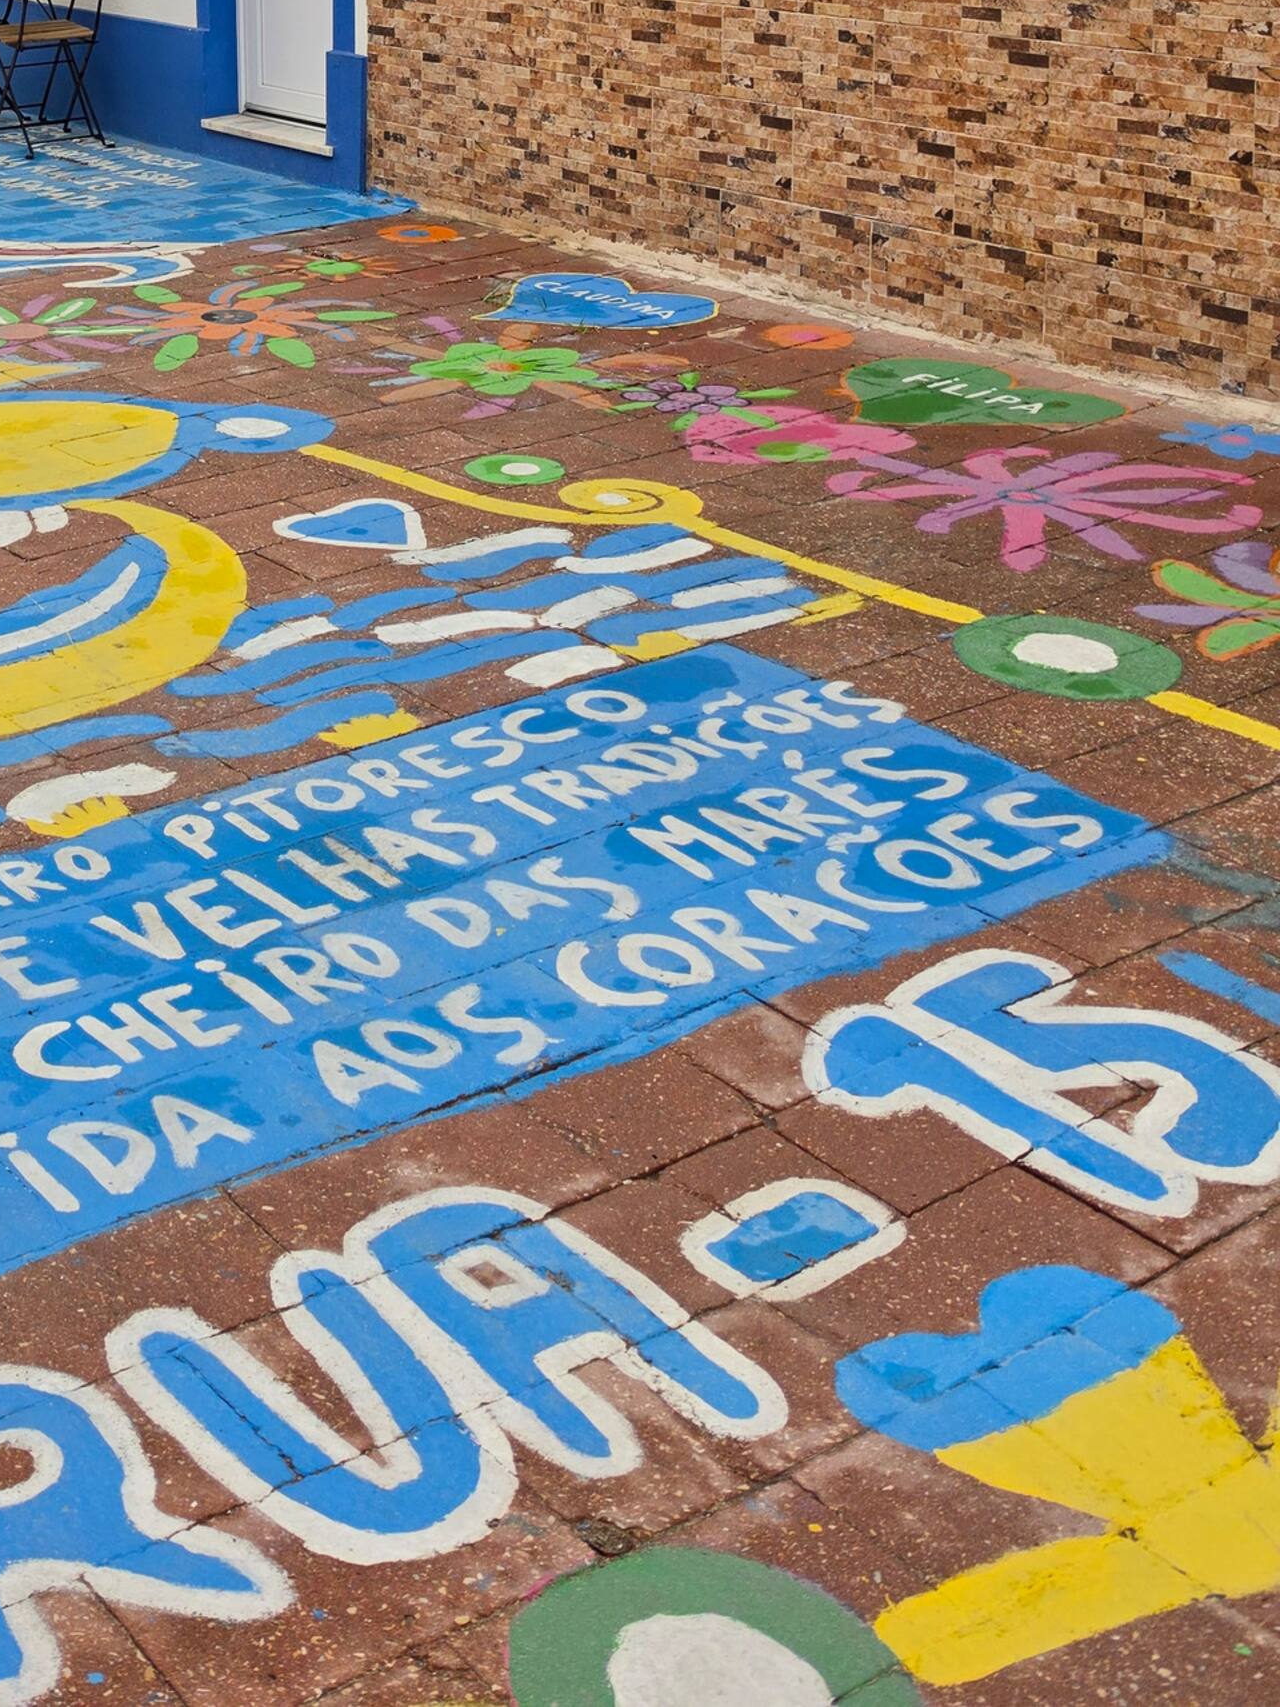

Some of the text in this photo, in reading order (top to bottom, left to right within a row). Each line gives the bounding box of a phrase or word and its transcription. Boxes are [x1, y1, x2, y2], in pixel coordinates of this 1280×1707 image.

[90, 808, 497, 960] VELHAS
[406, 857, 640, 949] DAS
[629, 747, 967, 880] MARÉS
[313, 984, 556, 1105] AOS
